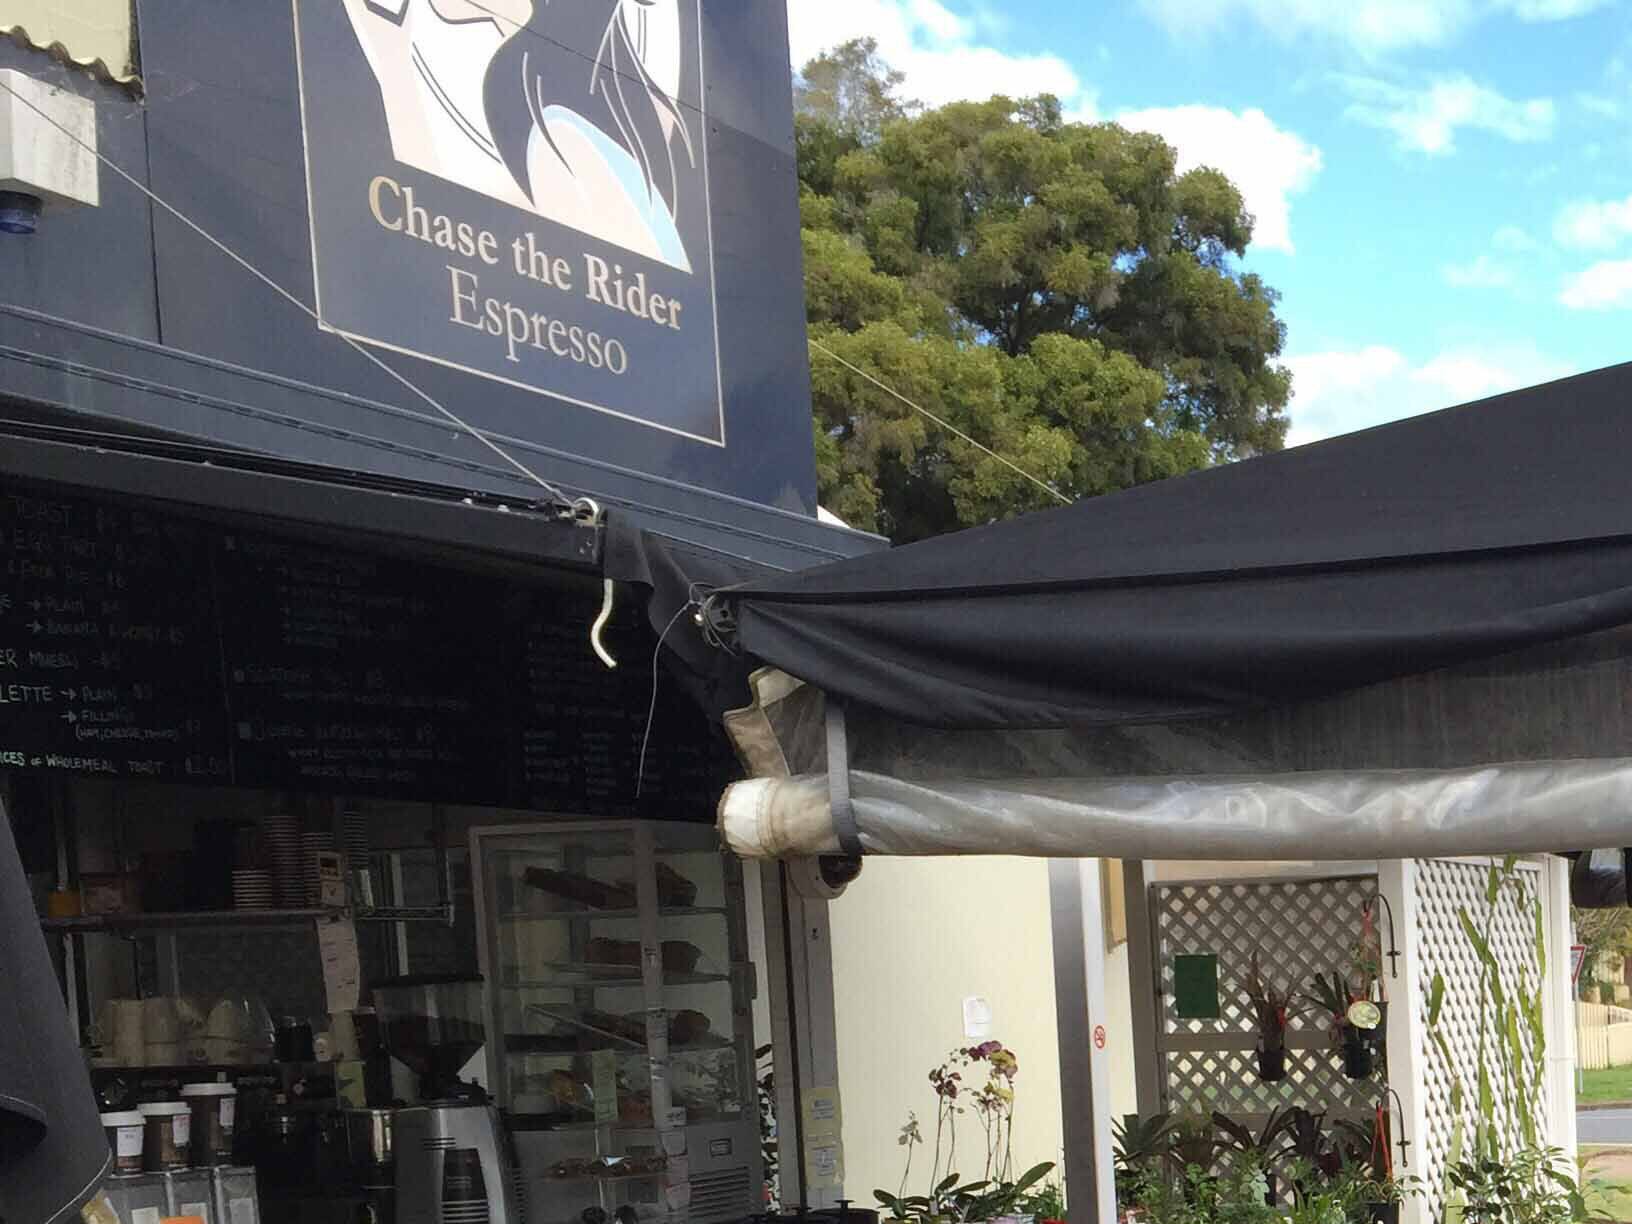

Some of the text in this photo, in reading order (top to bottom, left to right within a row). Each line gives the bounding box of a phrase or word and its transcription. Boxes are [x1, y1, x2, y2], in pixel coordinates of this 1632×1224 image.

[368, 175, 682, 331] Chase the Rider
[446, 264, 628, 375] Espresso
